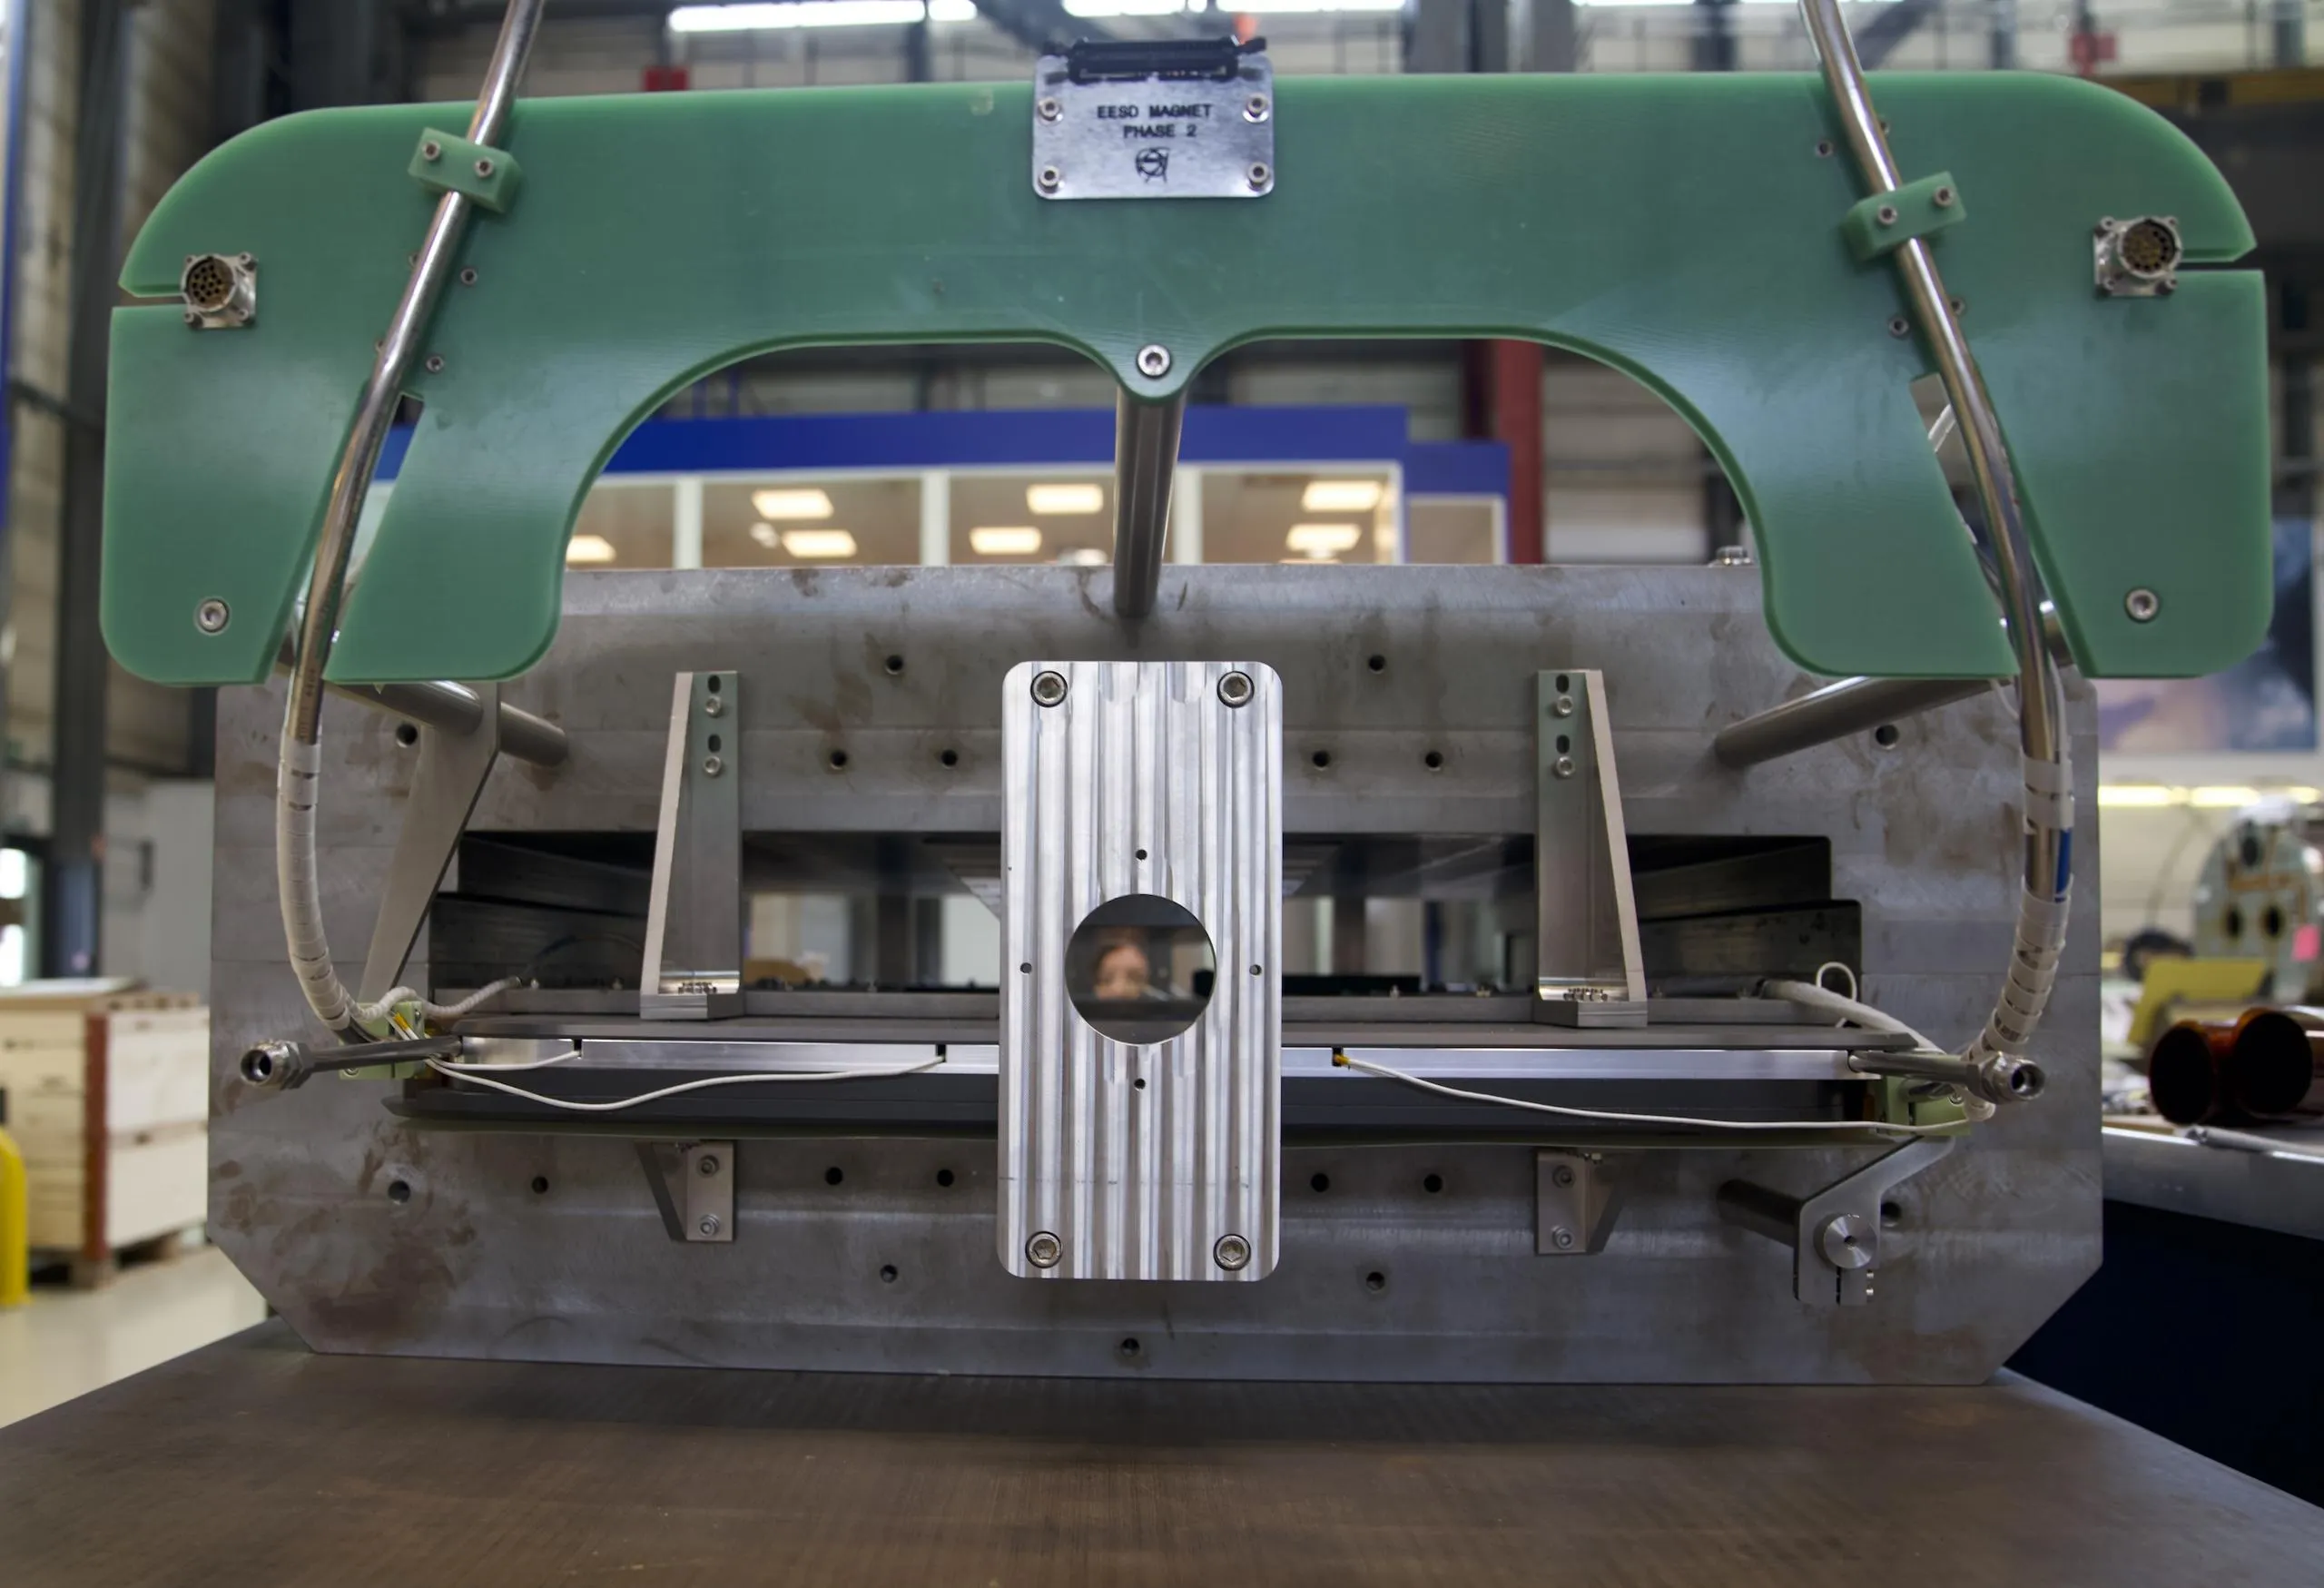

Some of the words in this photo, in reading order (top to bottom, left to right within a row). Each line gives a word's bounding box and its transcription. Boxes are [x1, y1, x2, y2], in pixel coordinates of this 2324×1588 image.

[1097, 104, 1139, 119] EESD
[1148, 104, 1213, 118] MAGNET
[1123, 123, 1176, 138] PHASE
[1186, 123, 1197, 137] 2
